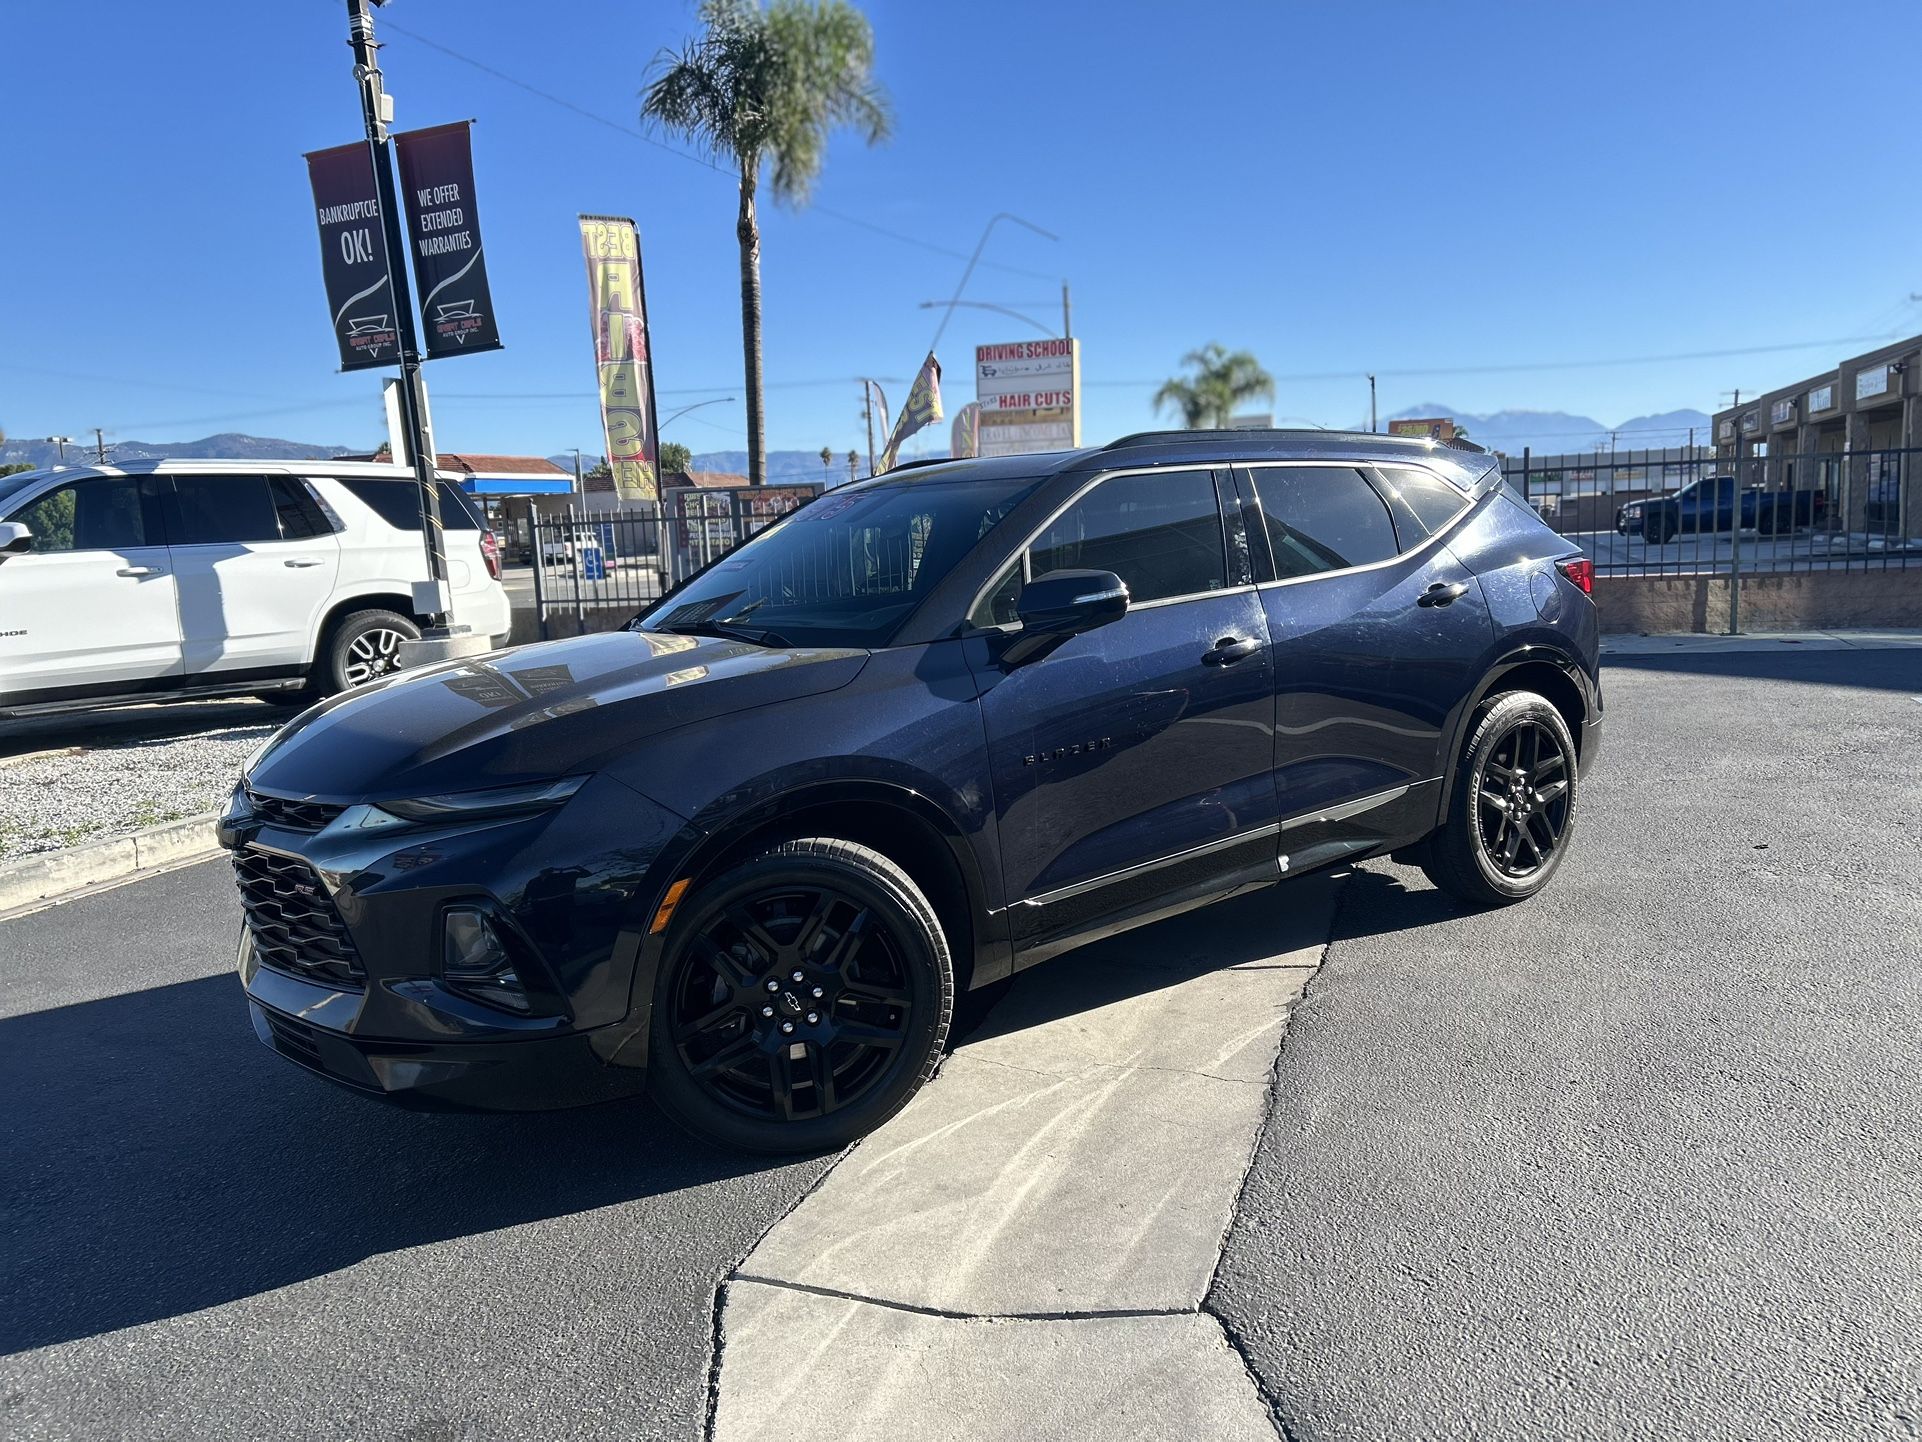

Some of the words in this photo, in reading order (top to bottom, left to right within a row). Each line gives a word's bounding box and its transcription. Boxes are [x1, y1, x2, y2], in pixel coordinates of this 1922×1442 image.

[417, 189, 432, 207] WE
[433, 183, 460, 203] OFFER
[318, 199, 378, 225] BANKRUPTCIE
[420, 208, 464, 232] EXTENDED
[340, 228, 374, 264] OK!
[418, 231, 472, 257] WARRANTIES
[977, 344, 1024, 362] DRIVING
[1026, 340, 1072, 359] SCHOOL
[999, 394, 1031, 409] HAIR
[1034, 391, 1071, 407] CUTS
[1023, 737, 1111, 767] BLAZER
[295, 884, 316, 896] RS
